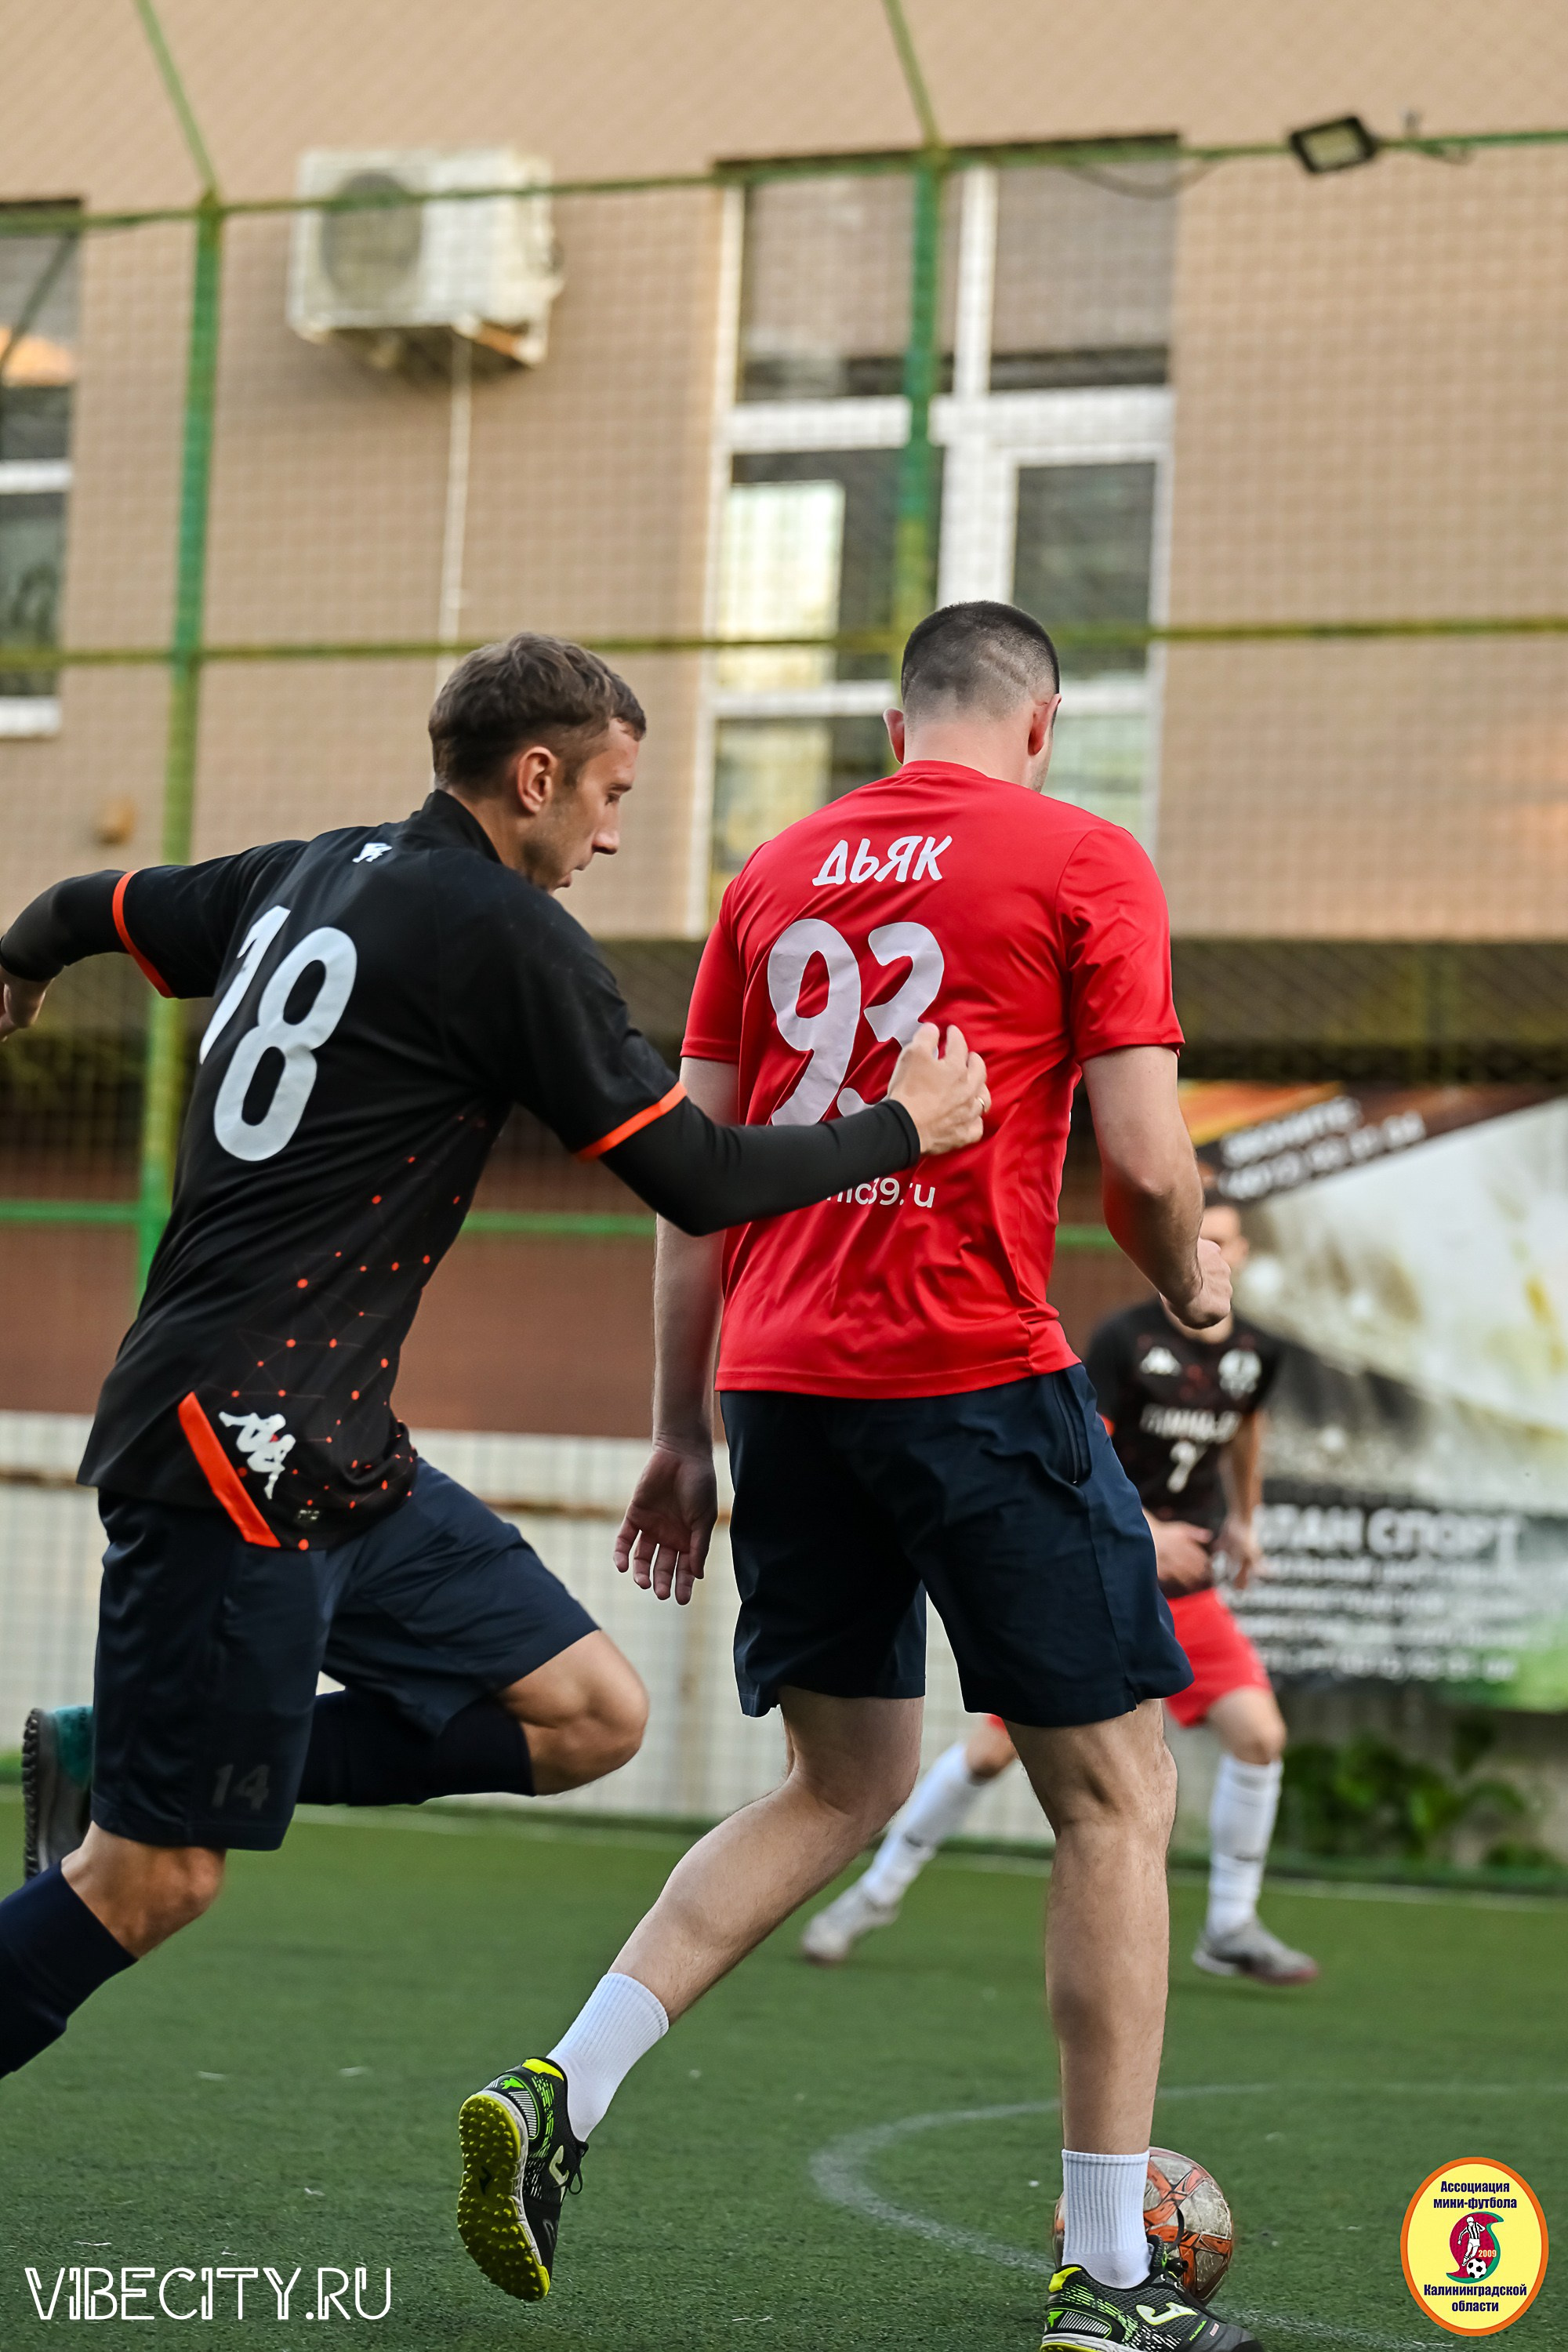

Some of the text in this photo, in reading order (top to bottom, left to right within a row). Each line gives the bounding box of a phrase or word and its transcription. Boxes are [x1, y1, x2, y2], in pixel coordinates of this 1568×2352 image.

[812, 836, 953, 886] ДЬЯК
[200, 905, 358, 1162] 18
[768, 918, 945, 1126] 93
[211, 1763, 270, 1812] 14
